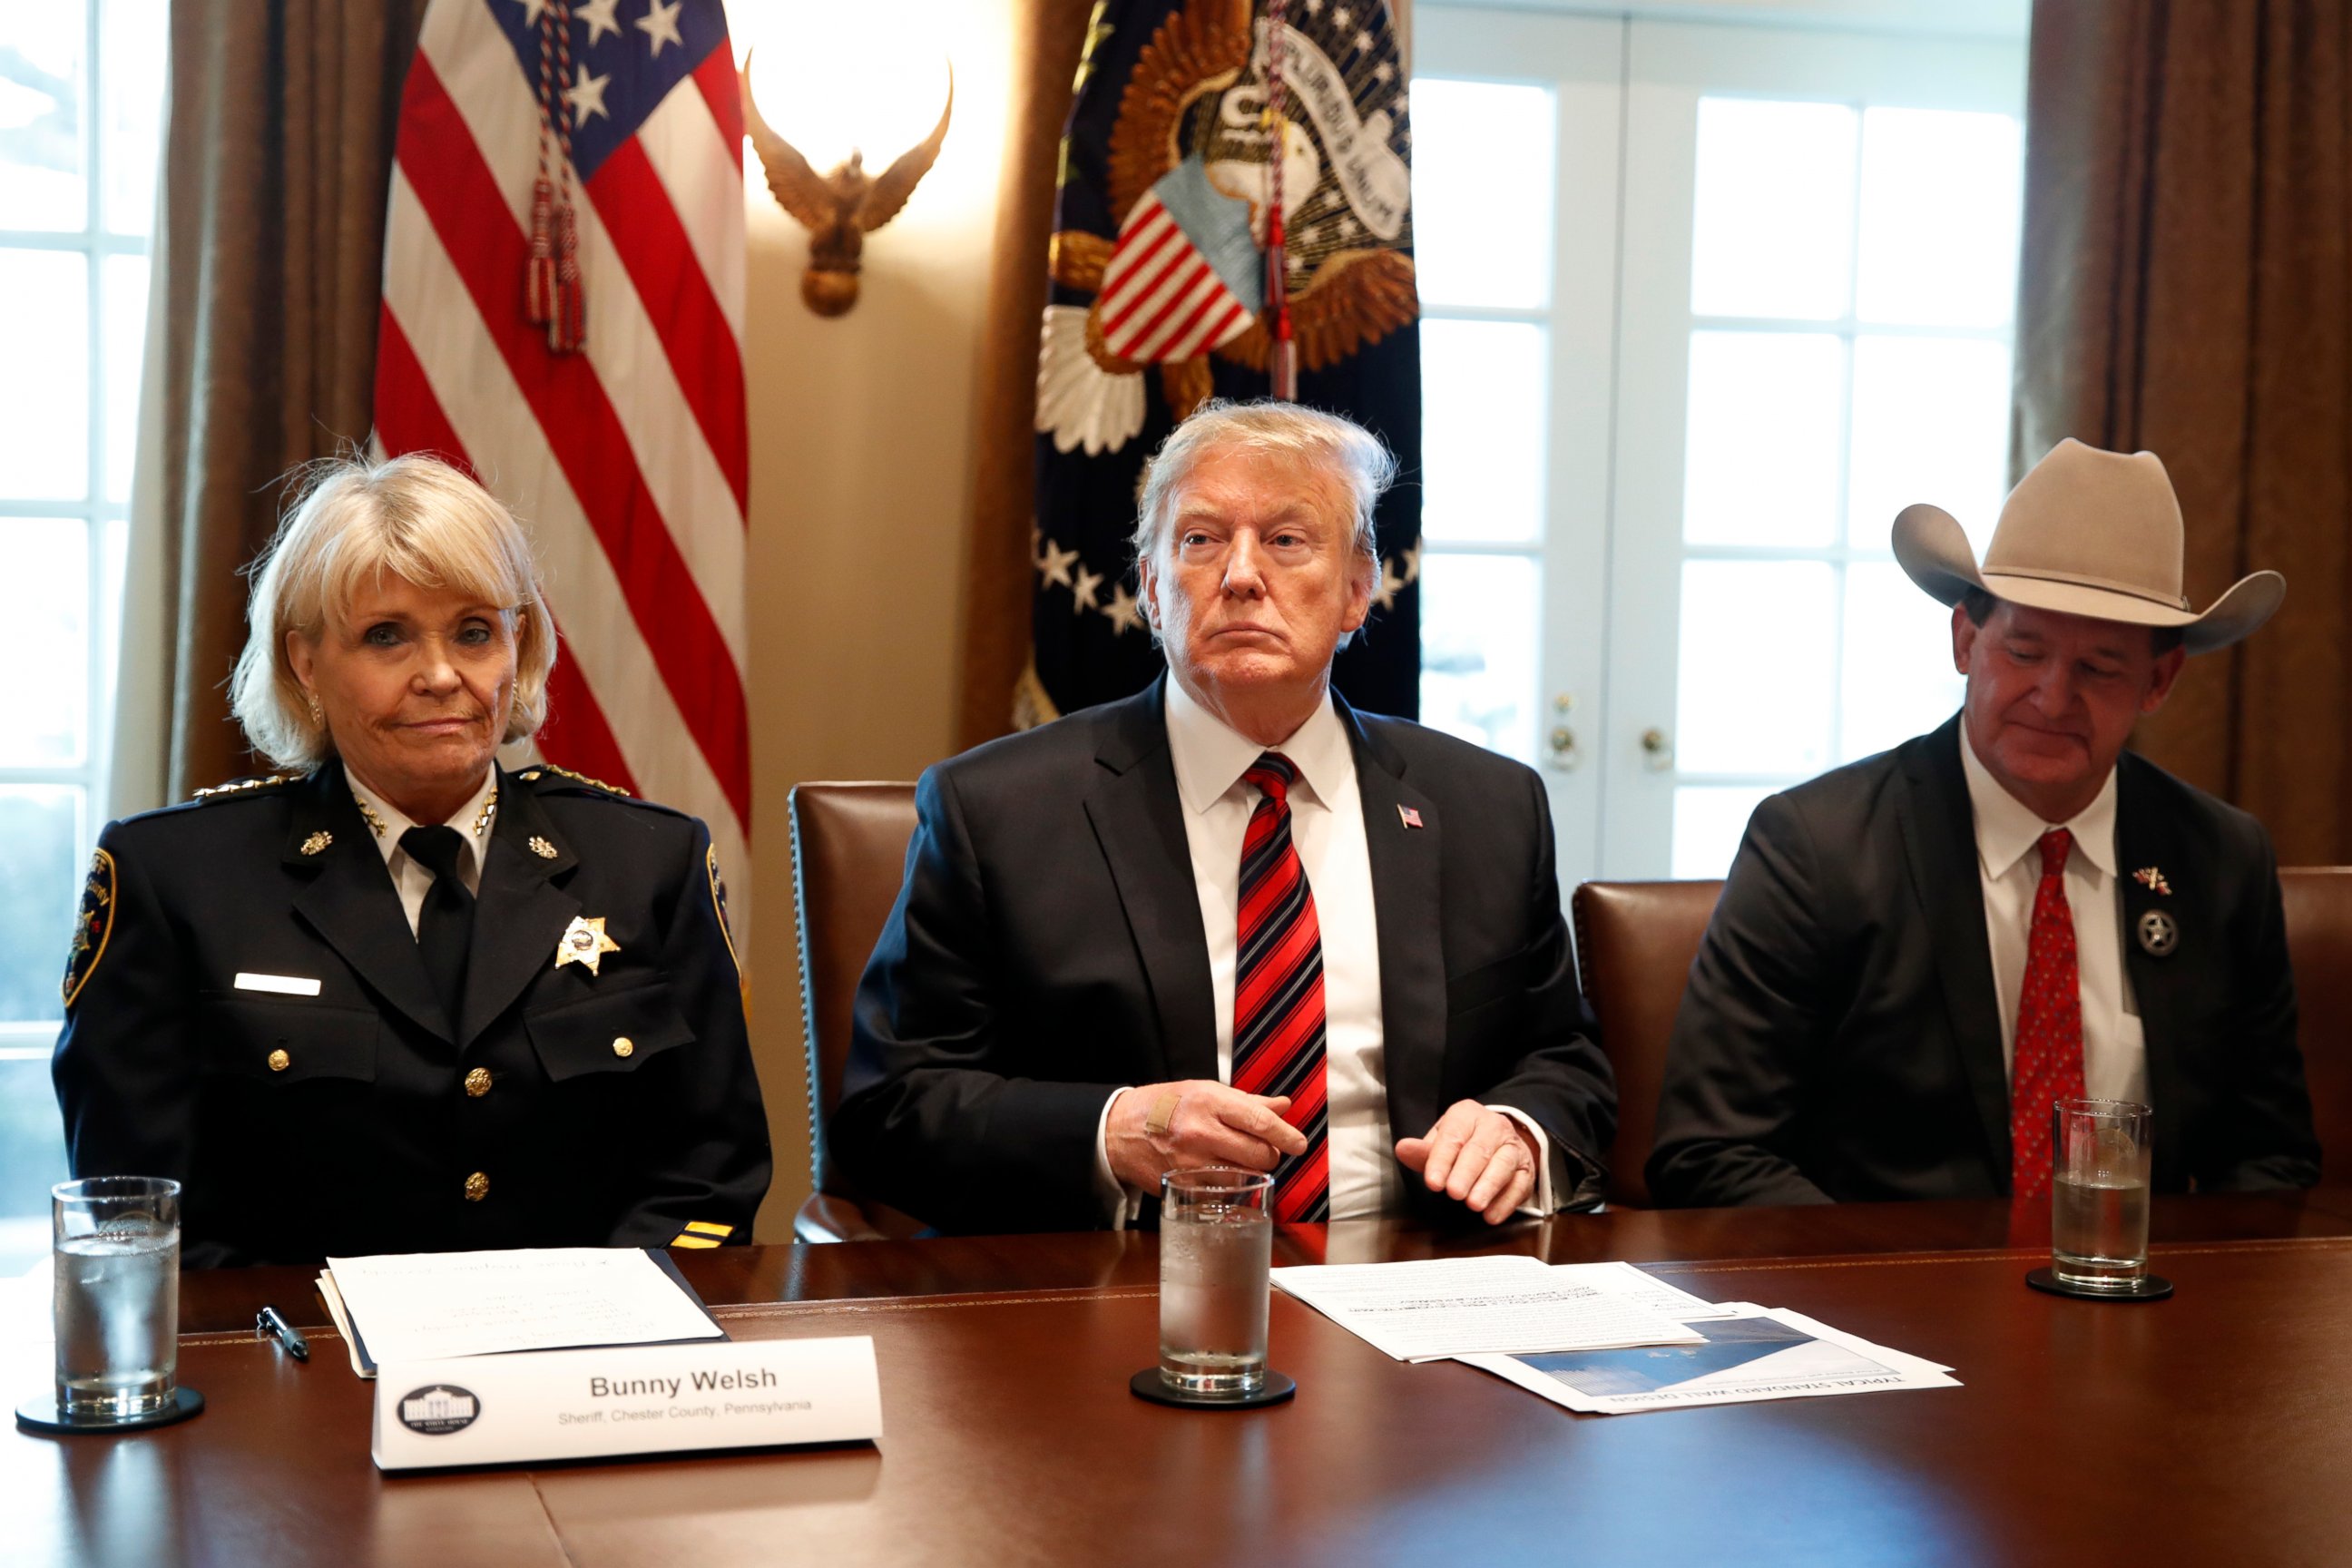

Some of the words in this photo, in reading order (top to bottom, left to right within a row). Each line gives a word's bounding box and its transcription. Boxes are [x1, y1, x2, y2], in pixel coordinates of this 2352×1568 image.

[590, 1376, 681, 1399] Bunny
[691, 1367, 778, 1391] Welsh
[1838, 1376, 1907, 1387] TYPICAL
[1681, 1388, 1731, 1398] WALL
[1736, 1381, 1833, 1395] STANDARD
[1609, 1393, 1678, 1403] DESIGN
[558, 1410, 606, 1426] Sheriff,
[611, 1407, 664, 1423] Chester
[669, 1403, 720, 1419] County,
[724, 1398, 812, 1416] Pennsylvania
